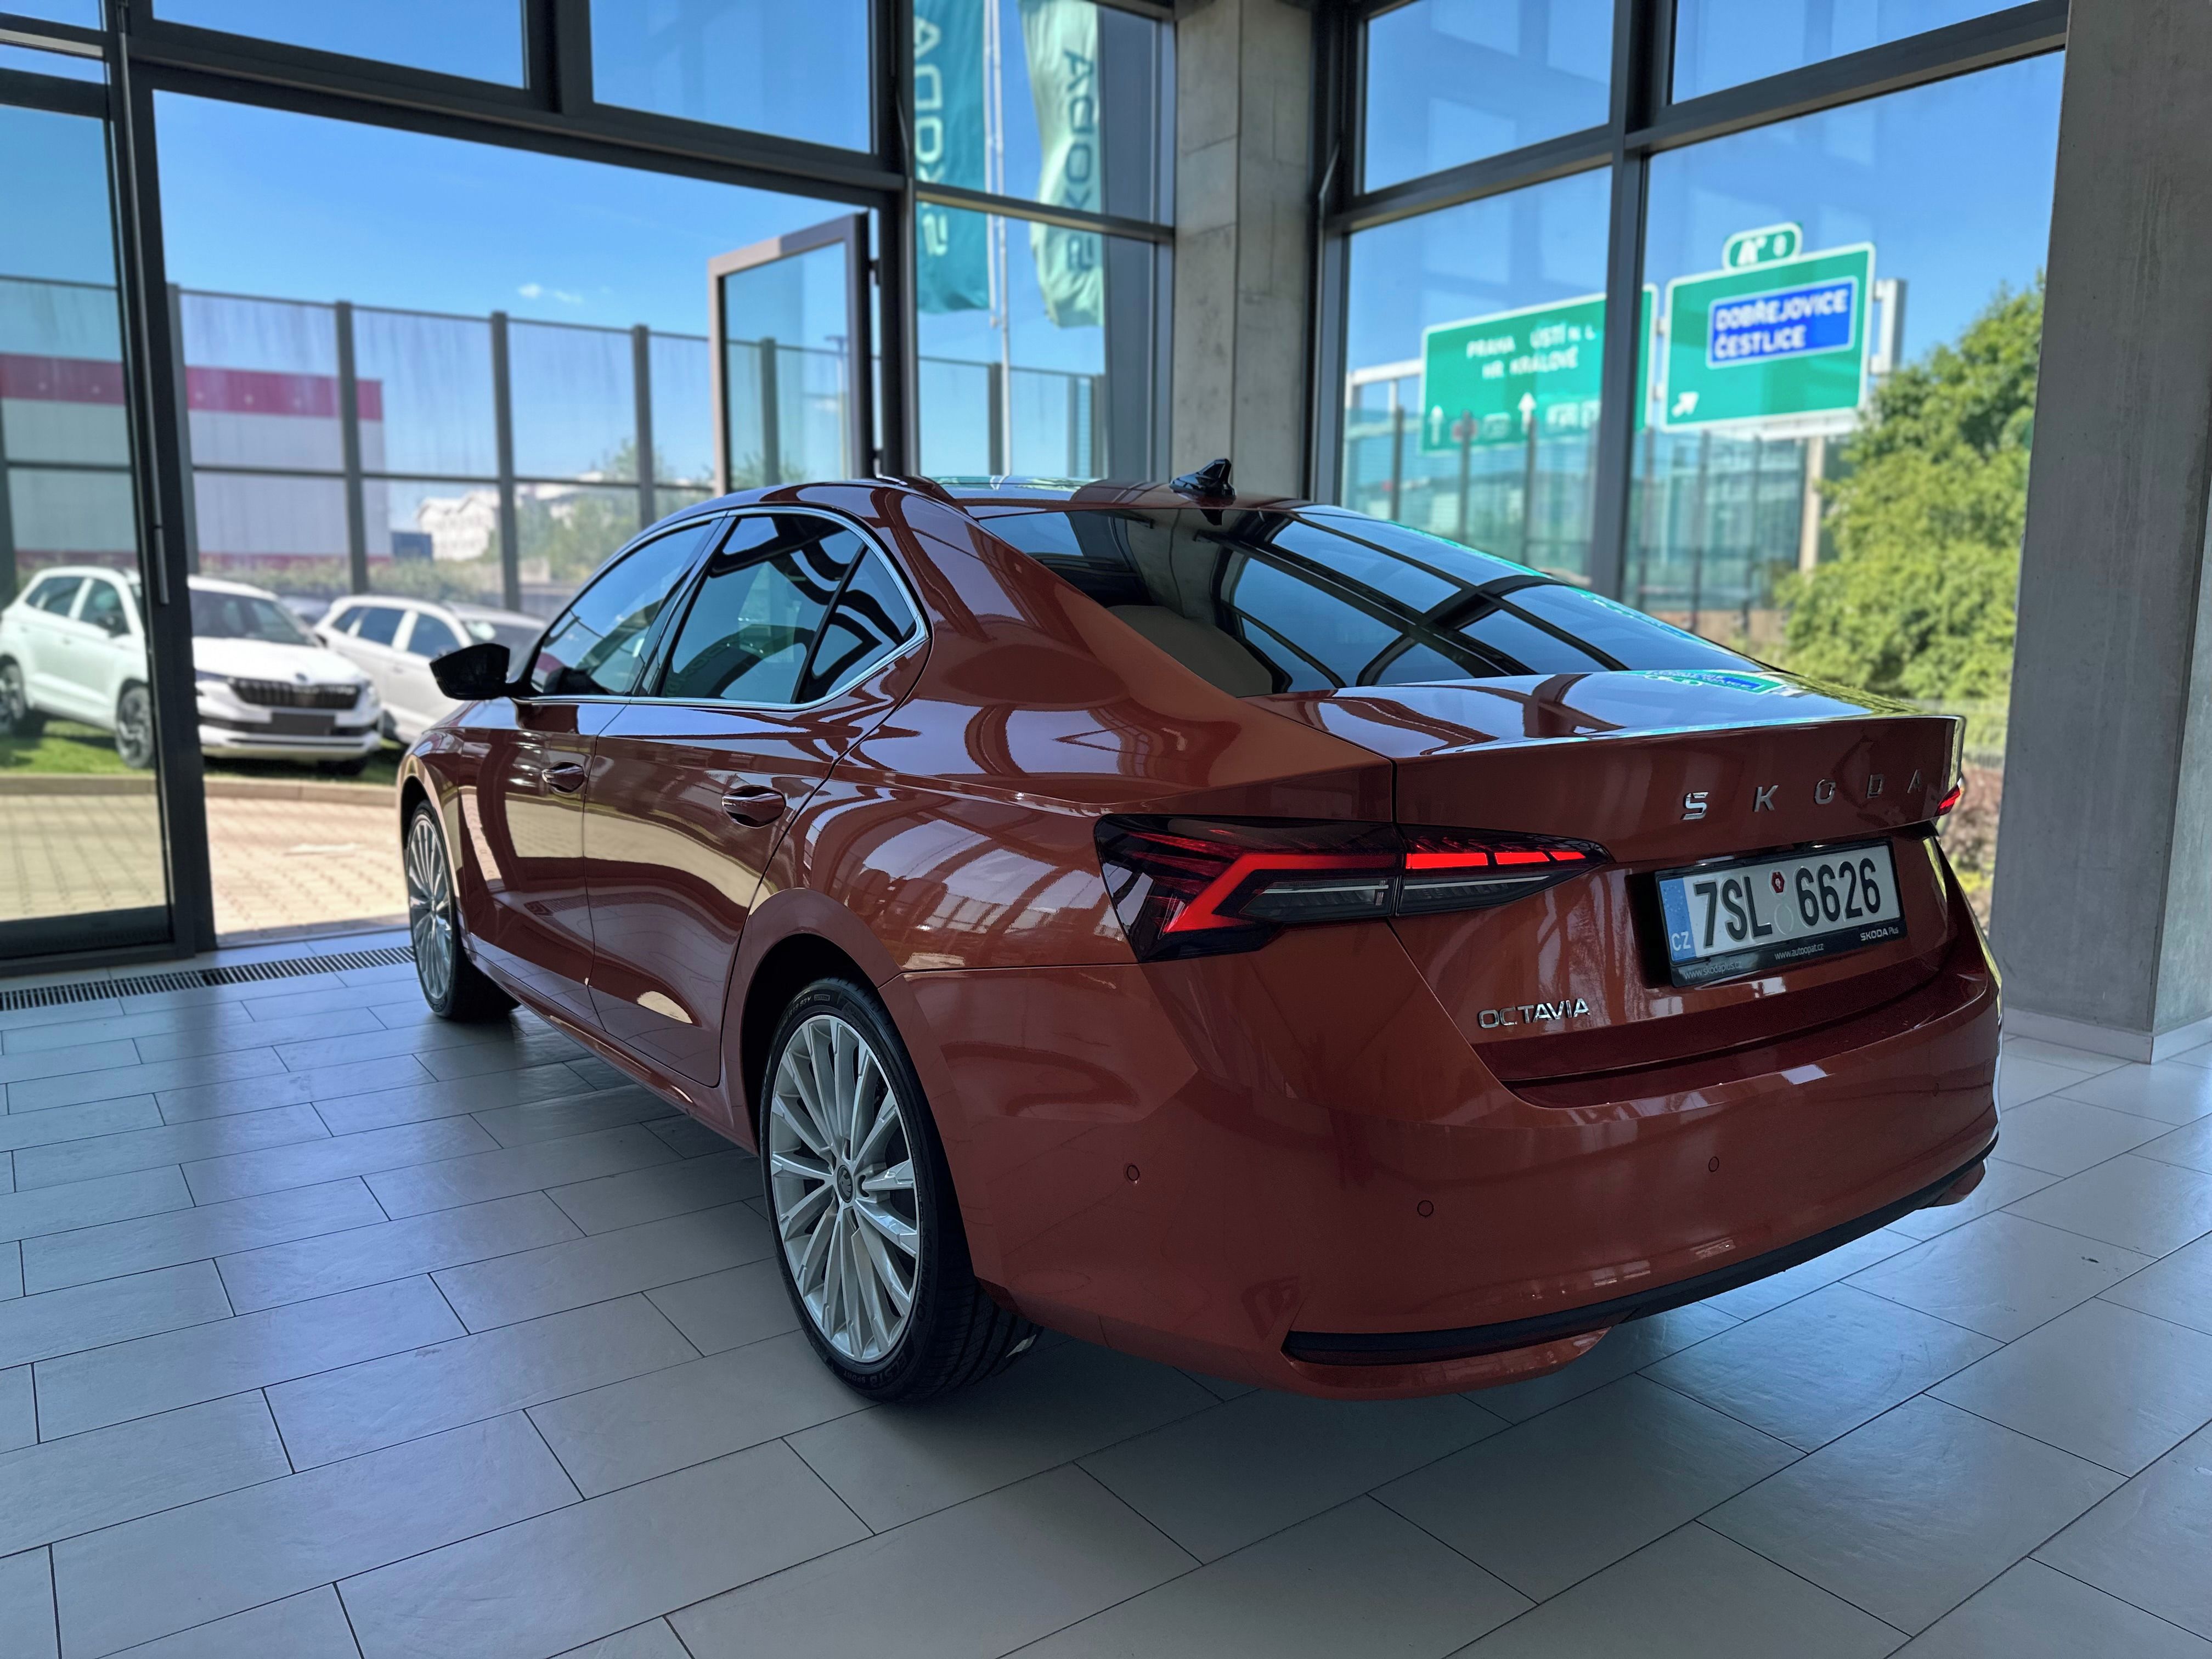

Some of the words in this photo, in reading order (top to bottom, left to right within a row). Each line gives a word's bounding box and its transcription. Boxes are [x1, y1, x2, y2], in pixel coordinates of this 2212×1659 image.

[1715, 289, 1849, 331] DOBŘEJOVICE
[1466, 335, 1516, 359] PRAHA
[1714, 324, 1807, 359] ČESTLICE
[1694, 876, 1773, 949] 7SL
[1795, 857, 1881, 927] 6626
[1671, 931, 1691, 951] CZ
[1888, 926, 1899, 935] Plus
[1774, 943, 1824, 960] www.autoopat.cz
[1683, 961, 1742, 980] www.skodaplus.cz
[1479, 997, 1590, 1029] OCTAVIA
